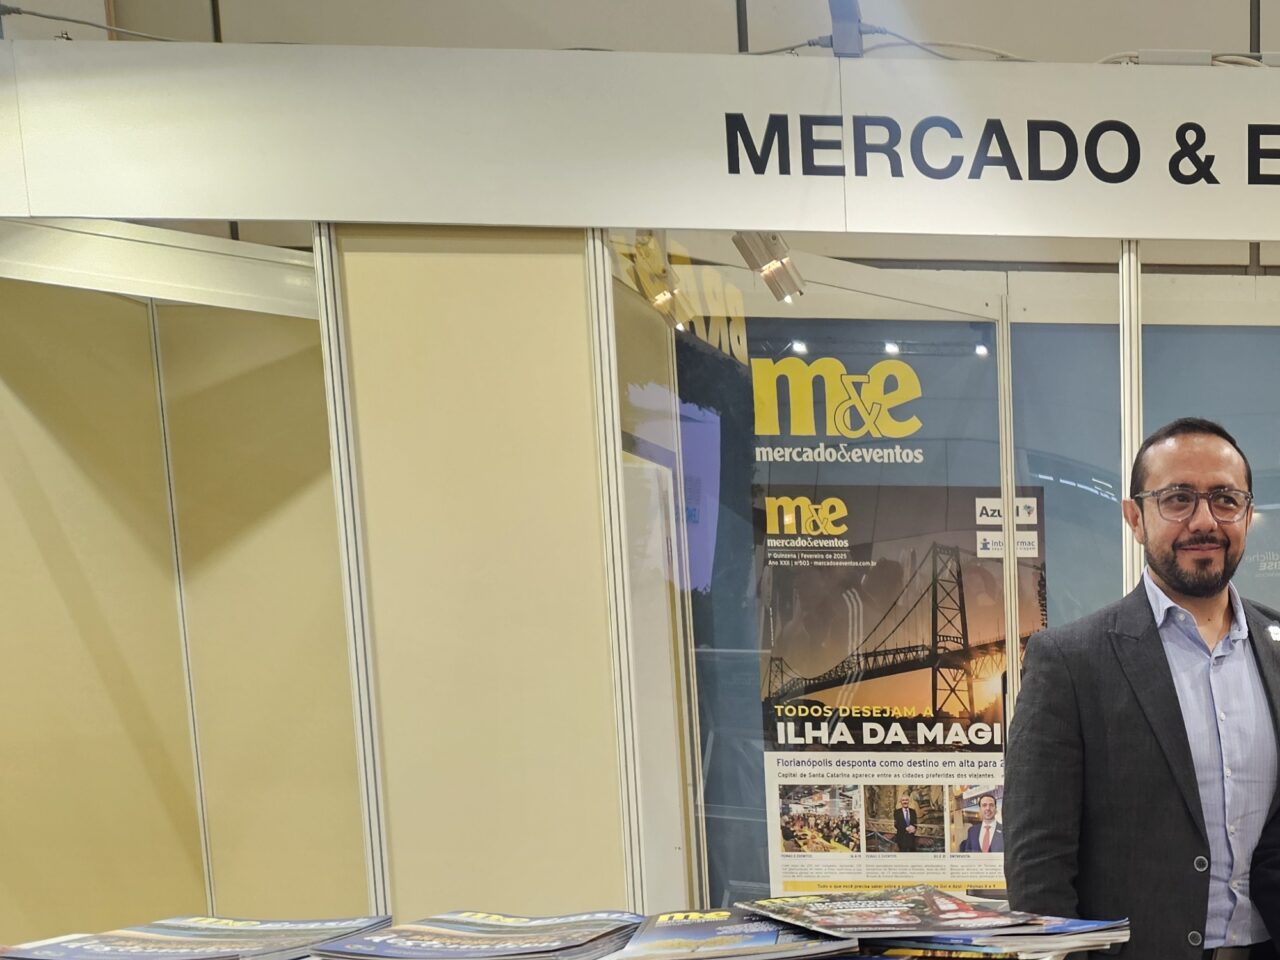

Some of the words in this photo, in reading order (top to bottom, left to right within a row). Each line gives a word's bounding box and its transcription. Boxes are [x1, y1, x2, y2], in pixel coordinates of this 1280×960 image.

[725, 112, 1142, 184] MERCADO
[1168, 121, 1221, 186] &
[750, 356, 923, 438] m&e
[756, 443, 924, 464] mercado&eventos
[764, 496, 848, 536] m&e
[767, 537, 849, 547] mercado&eventos
[774, 705, 832, 717] TODOS
[838, 705, 916, 718] DESEJAM
[922, 705, 934, 717] A
[777, 722, 855, 744] ILHA
[862, 722, 910, 745] DA
[917, 722, 1001, 745] MAGI
[777, 758, 832, 768] Florianópolis
[836, 759, 876, 768] desponta
[907, 759, 939, 767] destino
[959, 759, 975, 767] alta
[978, 760, 996, 769] para
